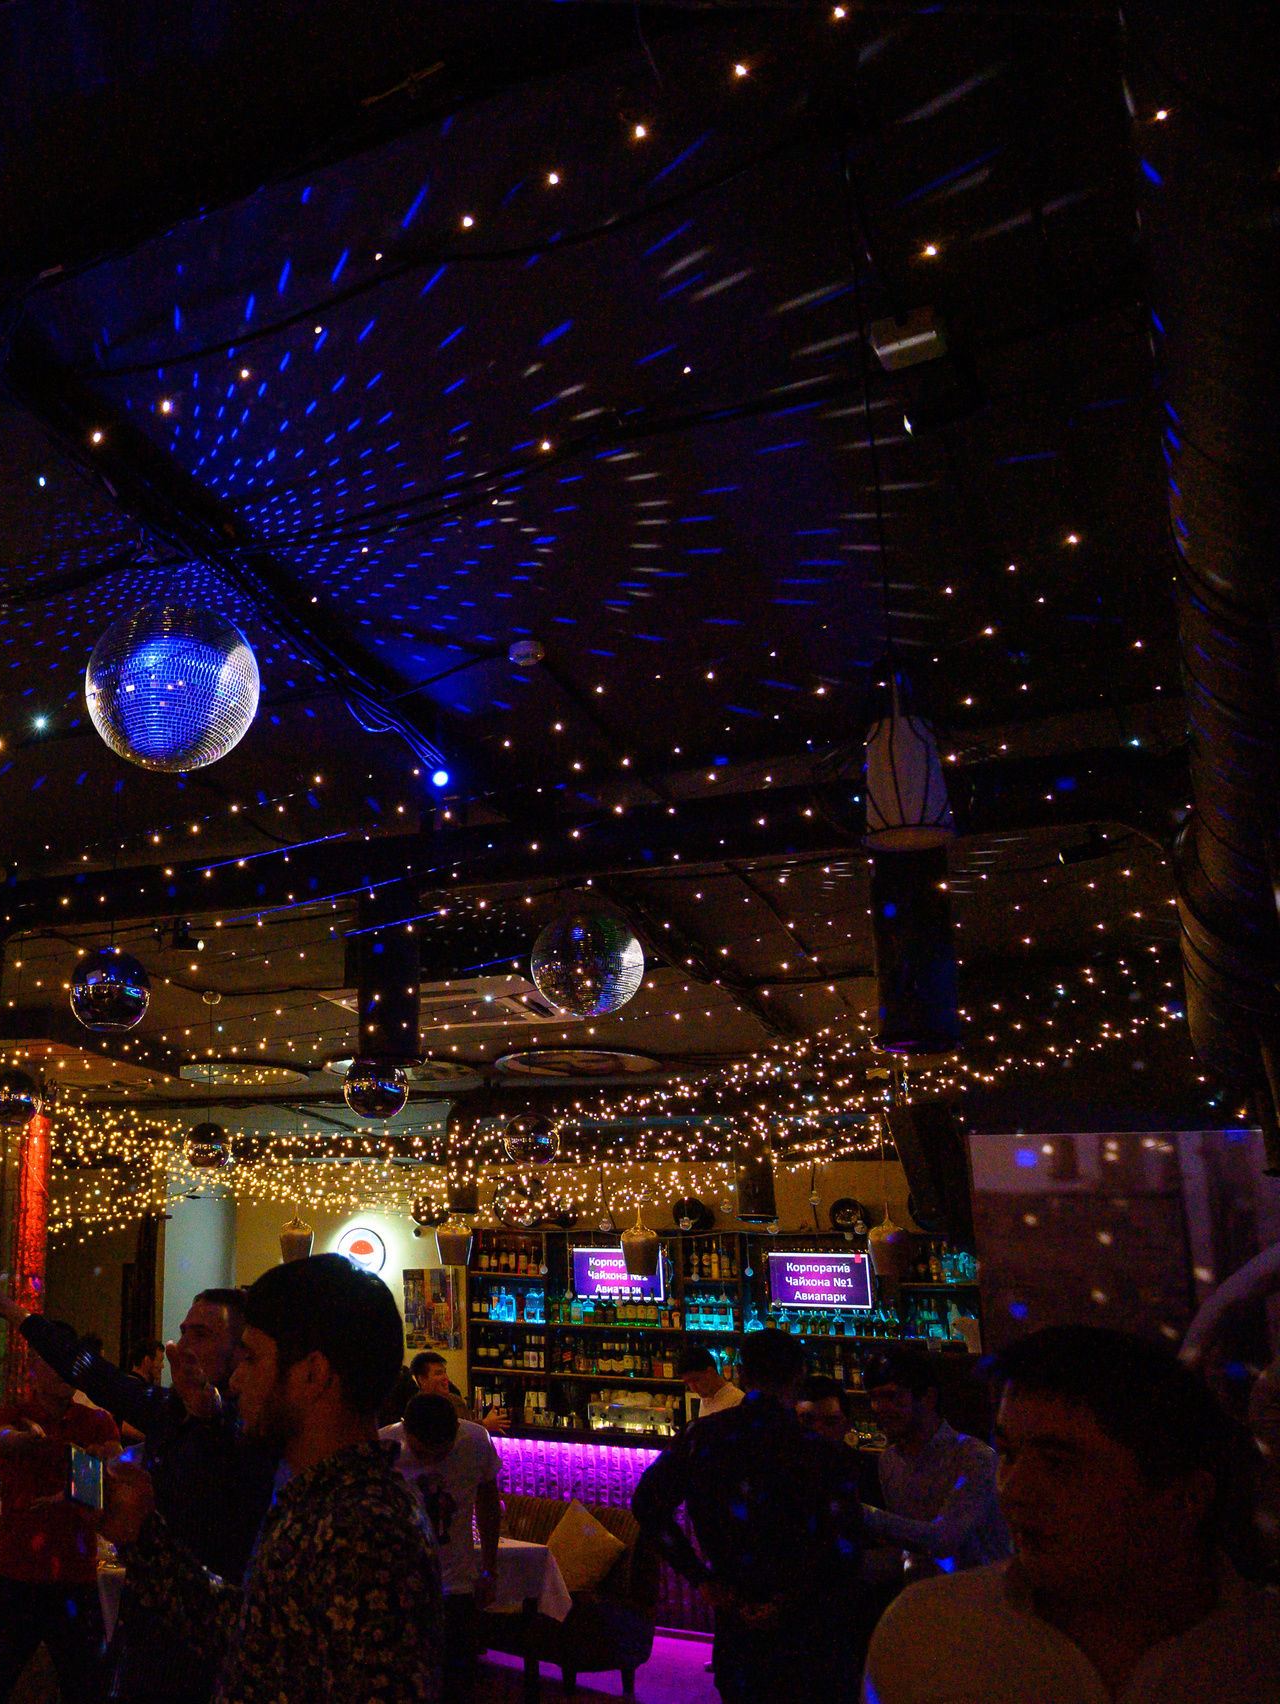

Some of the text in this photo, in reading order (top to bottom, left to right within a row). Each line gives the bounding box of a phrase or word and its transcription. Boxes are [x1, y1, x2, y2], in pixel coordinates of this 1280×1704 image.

[589, 1257, 626, 1268] Корпор
[786, 1262, 851, 1274] Корпоратив
[588, 1270, 627, 1280] Чайхона
[785, 1276, 853, 1288] Чайхона №1
[794, 1290, 847, 1303] Авиапарк
